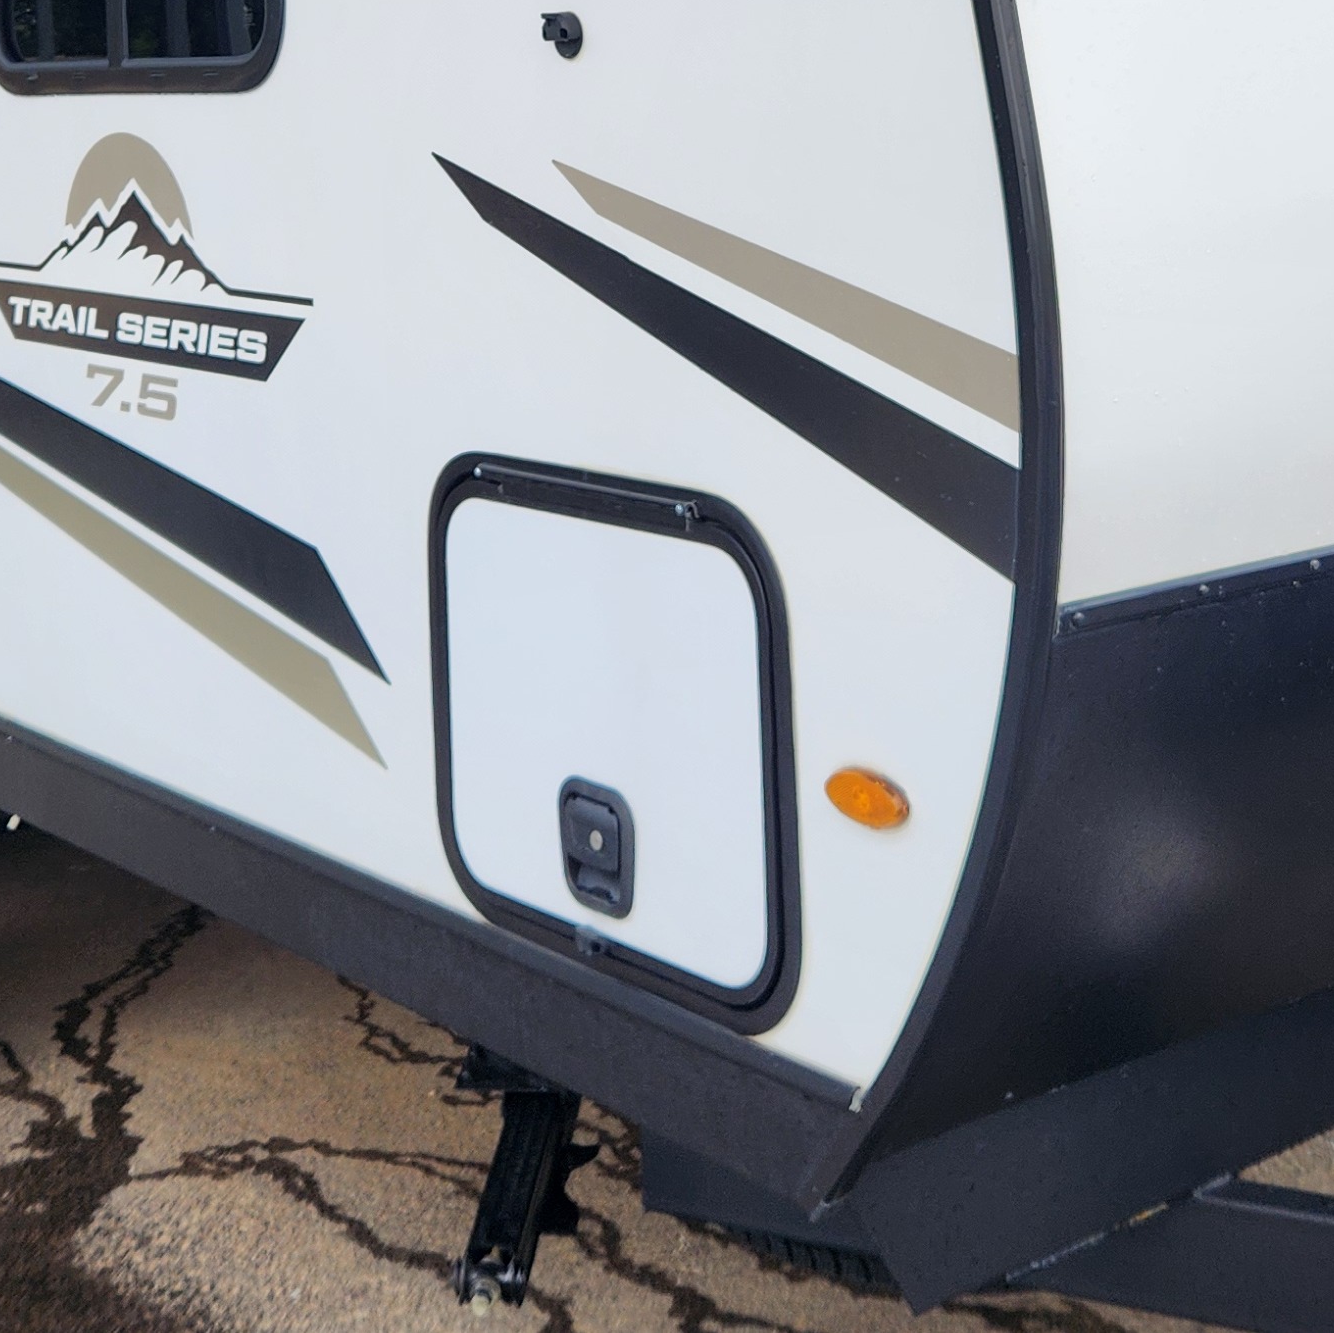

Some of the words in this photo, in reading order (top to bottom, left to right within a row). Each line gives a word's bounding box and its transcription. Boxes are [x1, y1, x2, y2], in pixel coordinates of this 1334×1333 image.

[8, 295, 109, 340] TRAIL
[116, 312, 268, 364] SERIES
[85, 363, 179, 421] 7.5
